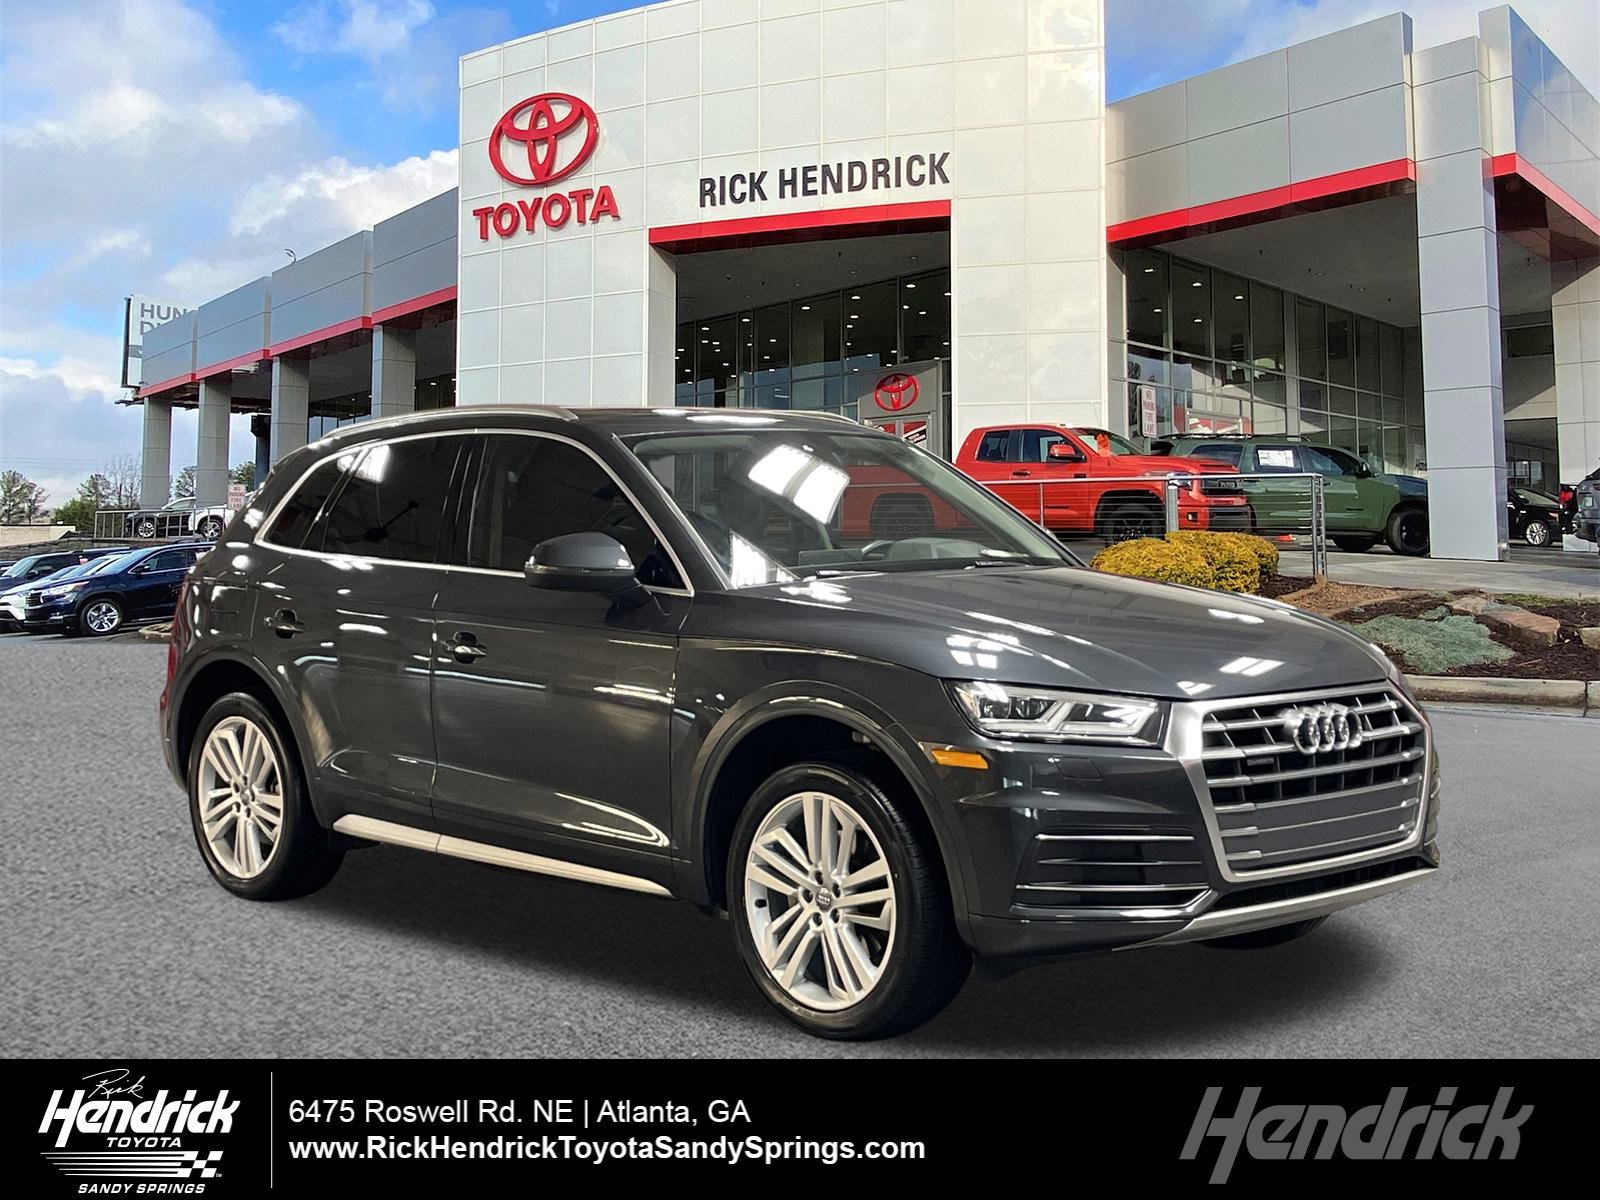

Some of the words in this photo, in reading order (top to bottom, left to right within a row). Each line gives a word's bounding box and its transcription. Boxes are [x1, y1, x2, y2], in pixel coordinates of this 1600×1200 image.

[700, 171, 767, 207] RICK
[779, 152, 951, 198] HENDRICK
[473, 185, 620, 240] TOYOTA
